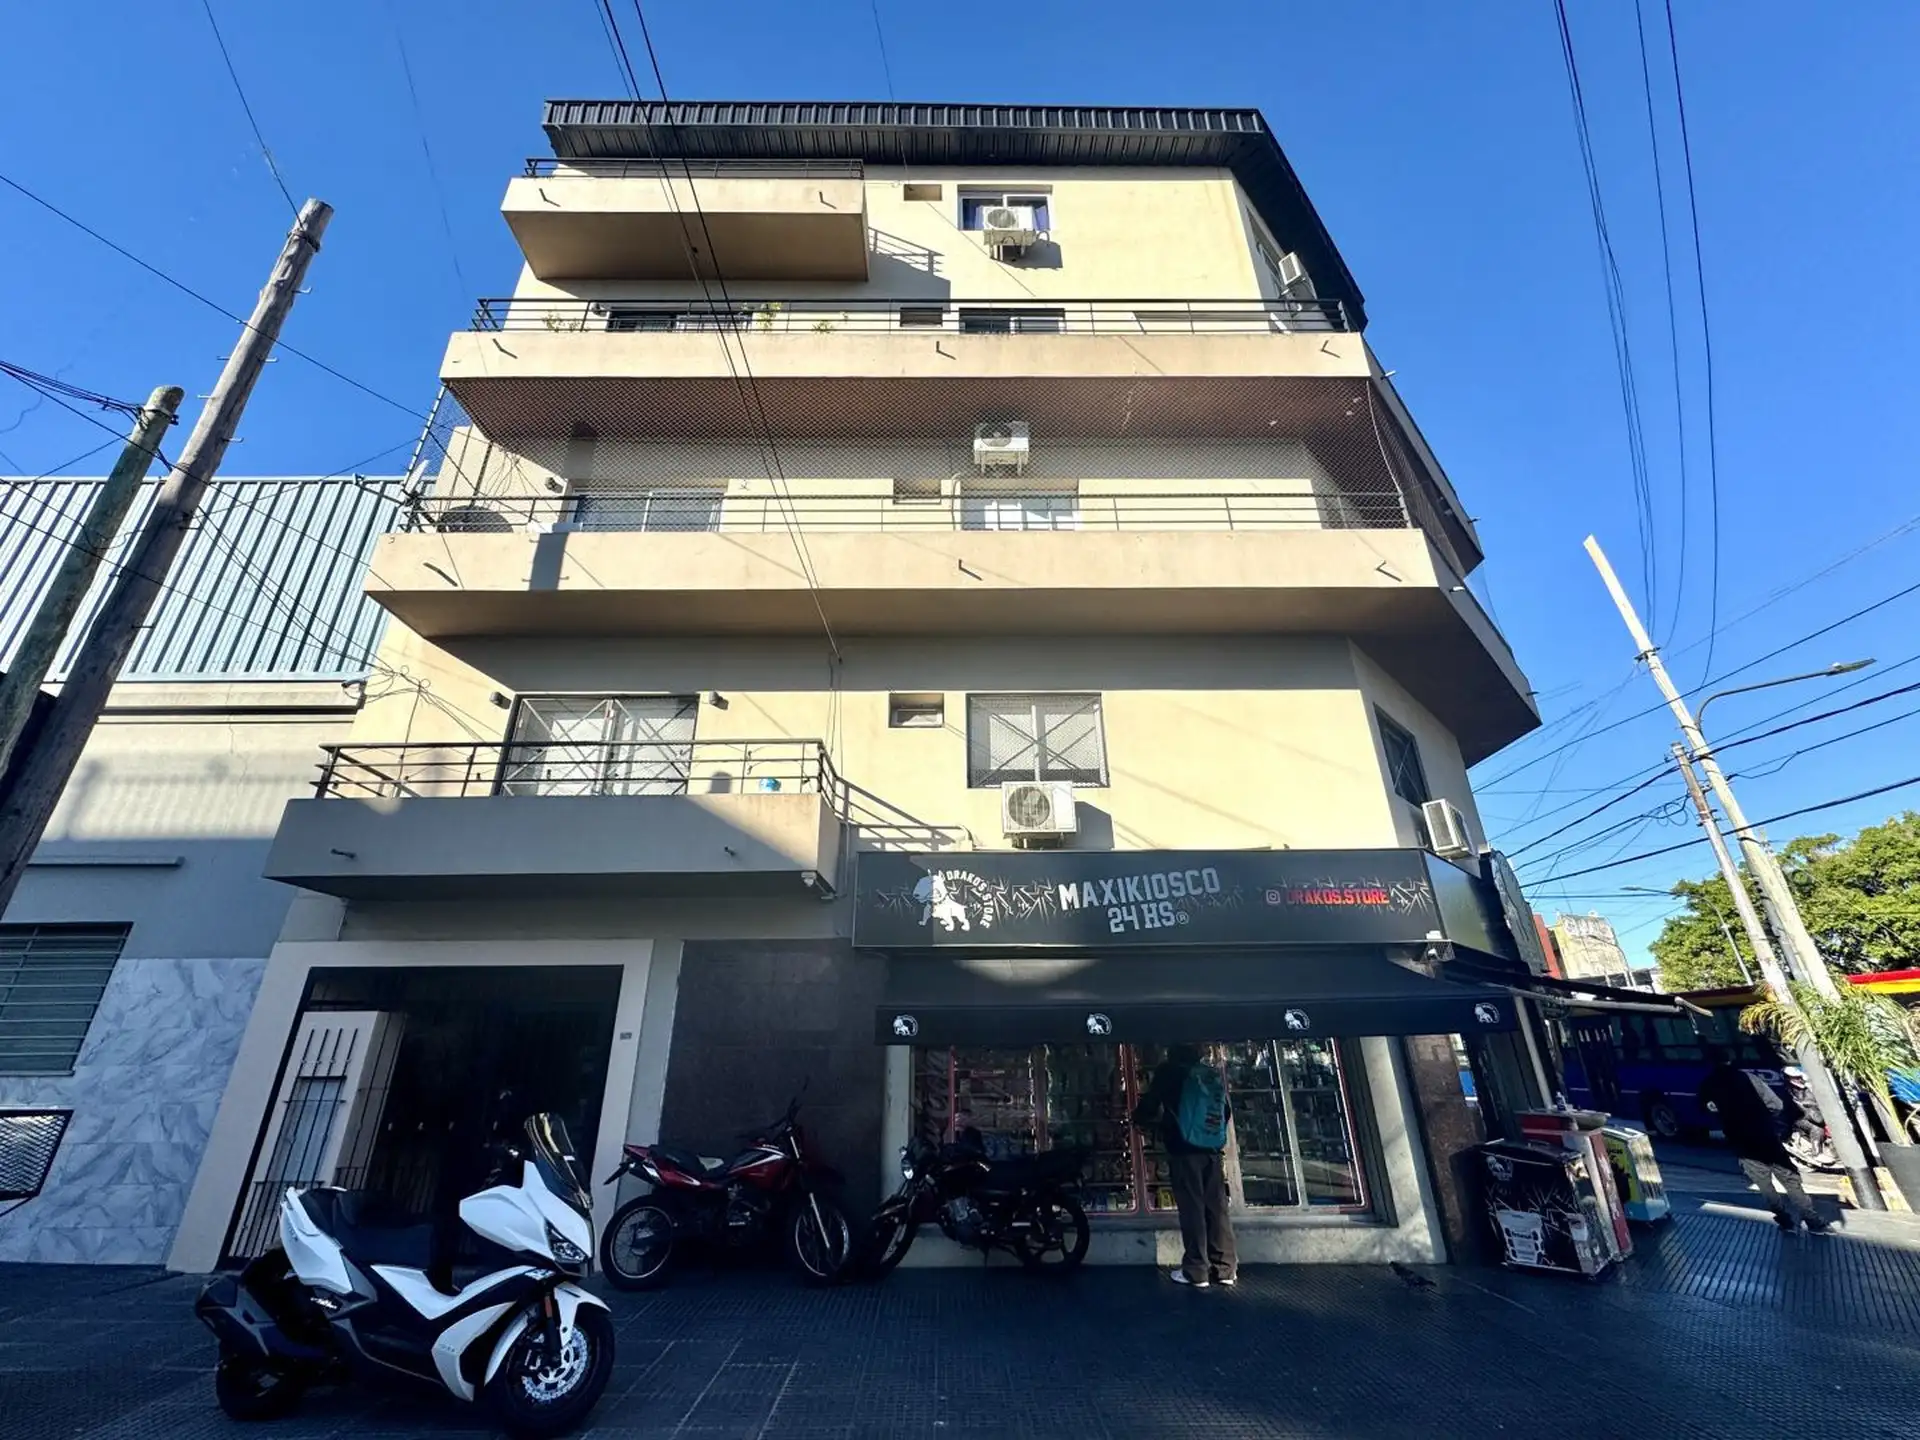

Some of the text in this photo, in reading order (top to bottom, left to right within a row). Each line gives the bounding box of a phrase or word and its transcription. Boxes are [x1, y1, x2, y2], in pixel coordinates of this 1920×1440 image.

[1058, 867, 1221, 911] MAXIKIOSCO
[979, 892, 995, 929] STORE
[1107, 906, 1140, 933] 24
